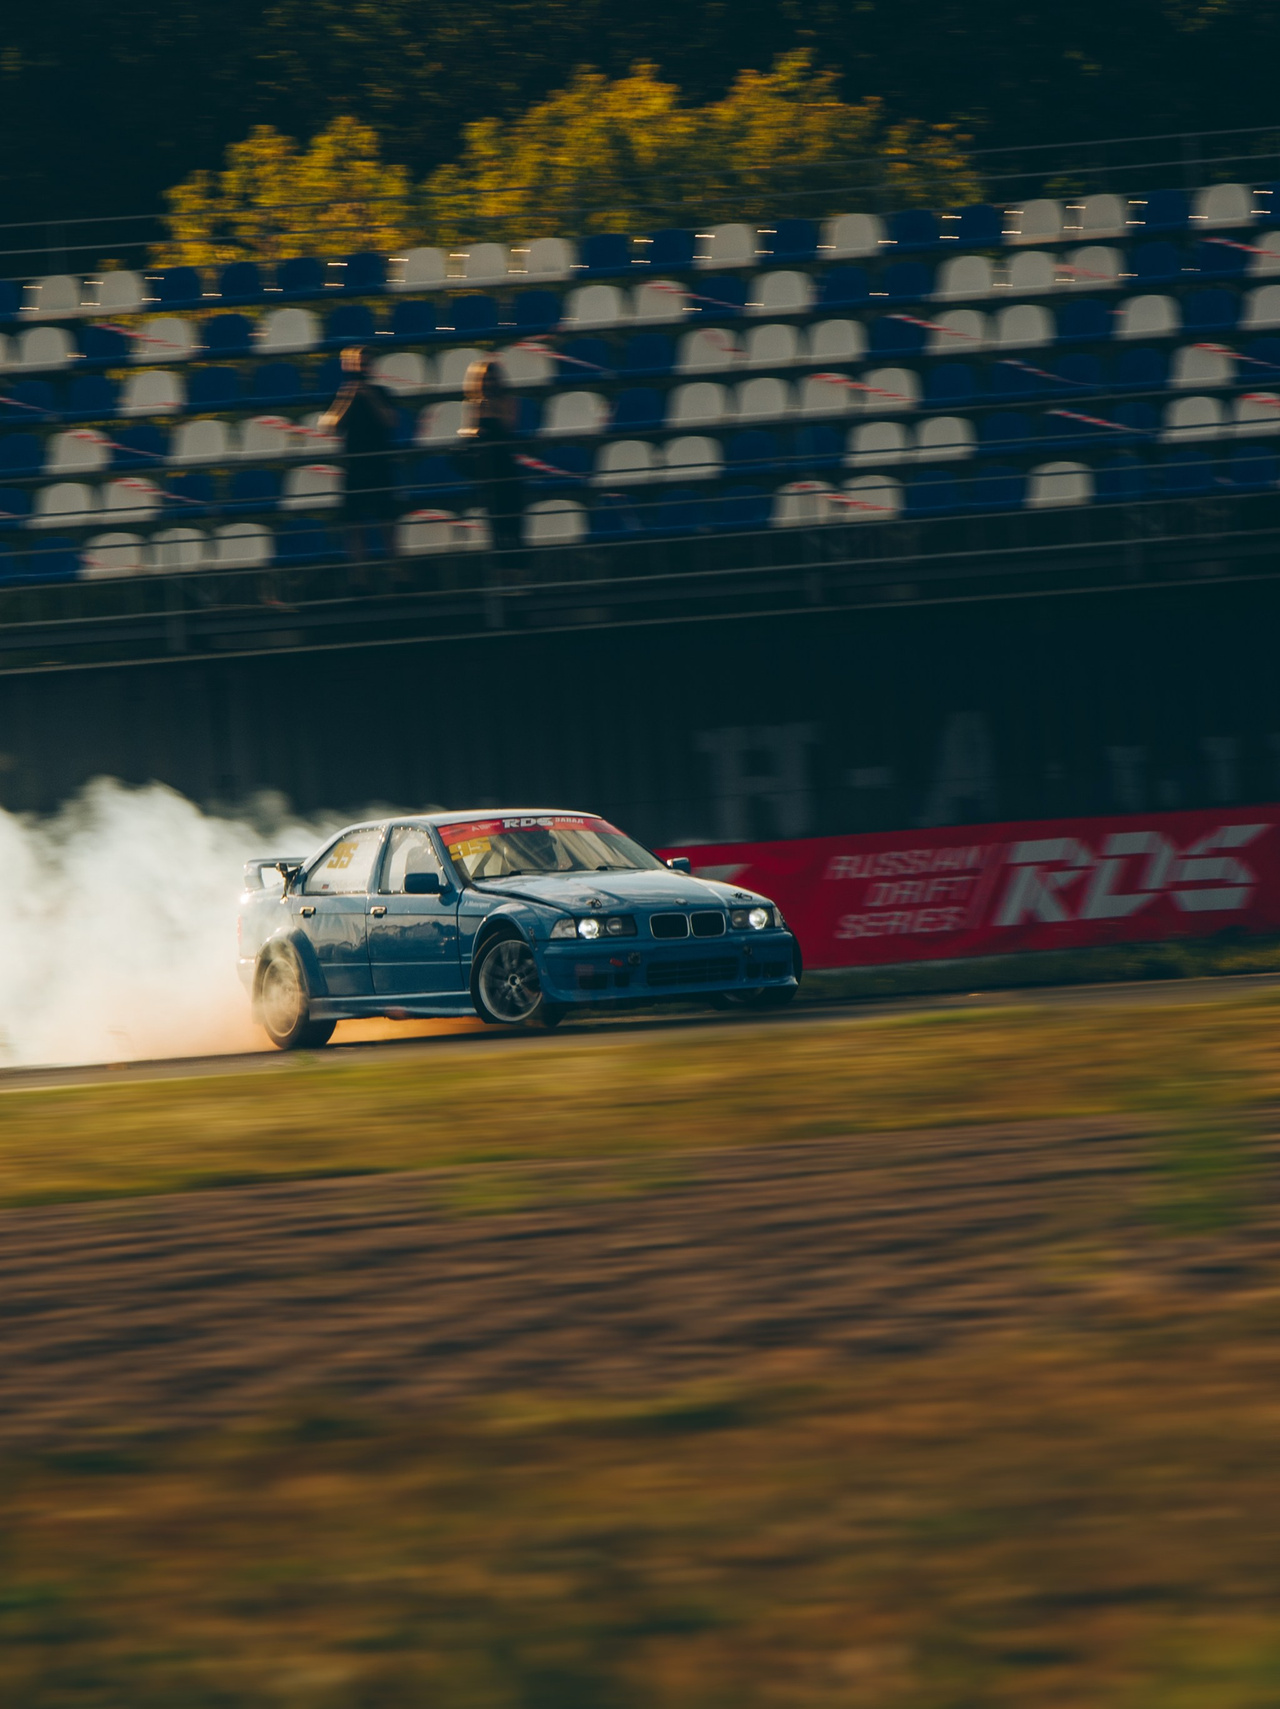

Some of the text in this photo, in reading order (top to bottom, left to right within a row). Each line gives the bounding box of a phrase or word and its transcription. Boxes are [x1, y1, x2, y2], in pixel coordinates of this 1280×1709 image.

[502, 817, 554, 829] RDS
[825, 845, 986, 880] RUSSIAN
[992, 823, 1272, 926] RDS
[865, 875, 974, 907] DRIFT
[834, 905, 968, 939] SERIES
